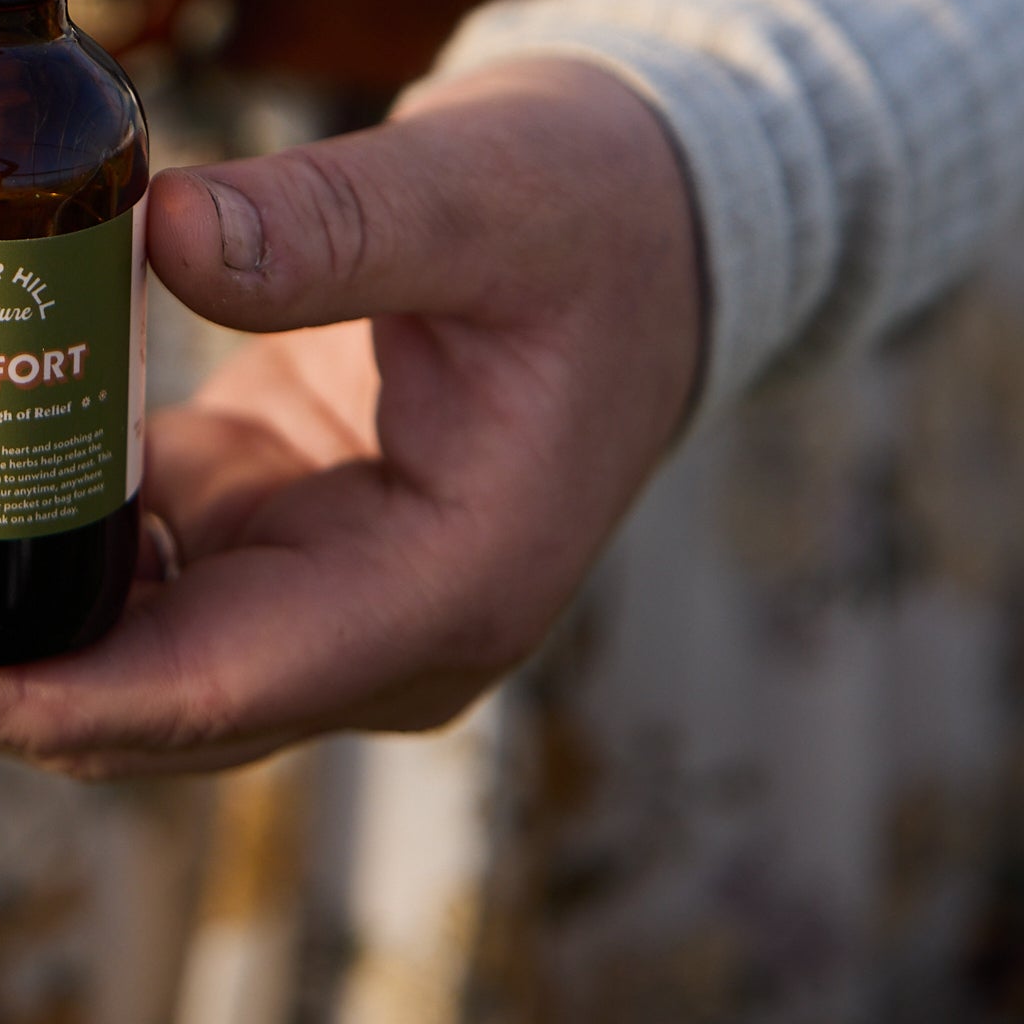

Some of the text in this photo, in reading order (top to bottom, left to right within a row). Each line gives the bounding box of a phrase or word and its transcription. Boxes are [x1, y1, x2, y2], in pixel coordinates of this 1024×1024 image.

[12, 266, 56, 320] HILL
[16, 408, 32, 421] of
[34, 401, 73, 419] Relief
[1, 445, 30, 456] heart
[32, 441, 52, 454] and
[54, 432, 93, 450] soothing
[94, 427, 104, 438] an
[9, 457, 38, 470] herbs
[41, 454, 63, 466] help
[65, 449, 87, 462] relax
[88, 442, 102, 453] the
[4, 474, 15, 484] to
[17, 467, 56, 483] unwind
[58, 463, 76, 477] and
[77, 458, 96, 471] rest.
[13, 484, 59, 498] anytime,
[60, 469, 103, 490] anywhere
[3, 499, 40, 514] pocket
[41, 496, 53, 507] or
[53, 493, 72, 505] bag
[73, 488, 87, 500] for
[87, 481, 105, 494] easy
[10, 514, 25, 524] on
[27, 515, 34, 523] a
[35, 508, 58, 522] hard
[59, 505, 79, 519] day.
